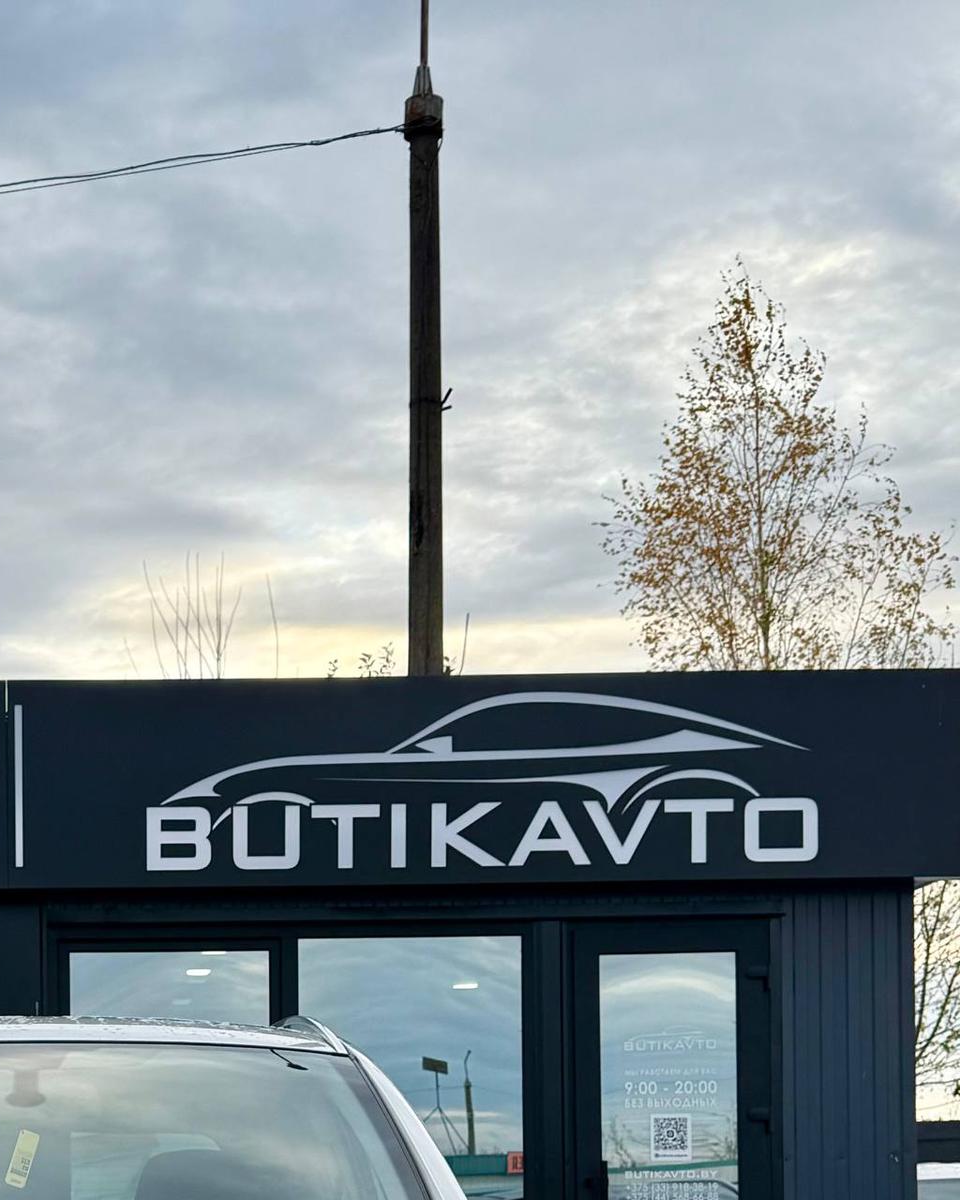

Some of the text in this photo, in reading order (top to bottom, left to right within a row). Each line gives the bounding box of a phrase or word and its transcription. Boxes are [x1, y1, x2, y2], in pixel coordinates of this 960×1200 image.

[146, 797, 819, 872] BUTIKAVTO
[623, 1039, 717, 1051] BUTIKAVTO
[625, 1081, 658, 1095] 9:00
[674, 1080, 718, 1094] 20:00
[624, 1097, 716, 1108] БЕЗ ВЫХОДНЫХ
[624, 1170, 718, 1179] BUTIKAVTO.BY
[626, 1183, 719, 1194] +375 (33) 918-38-19
